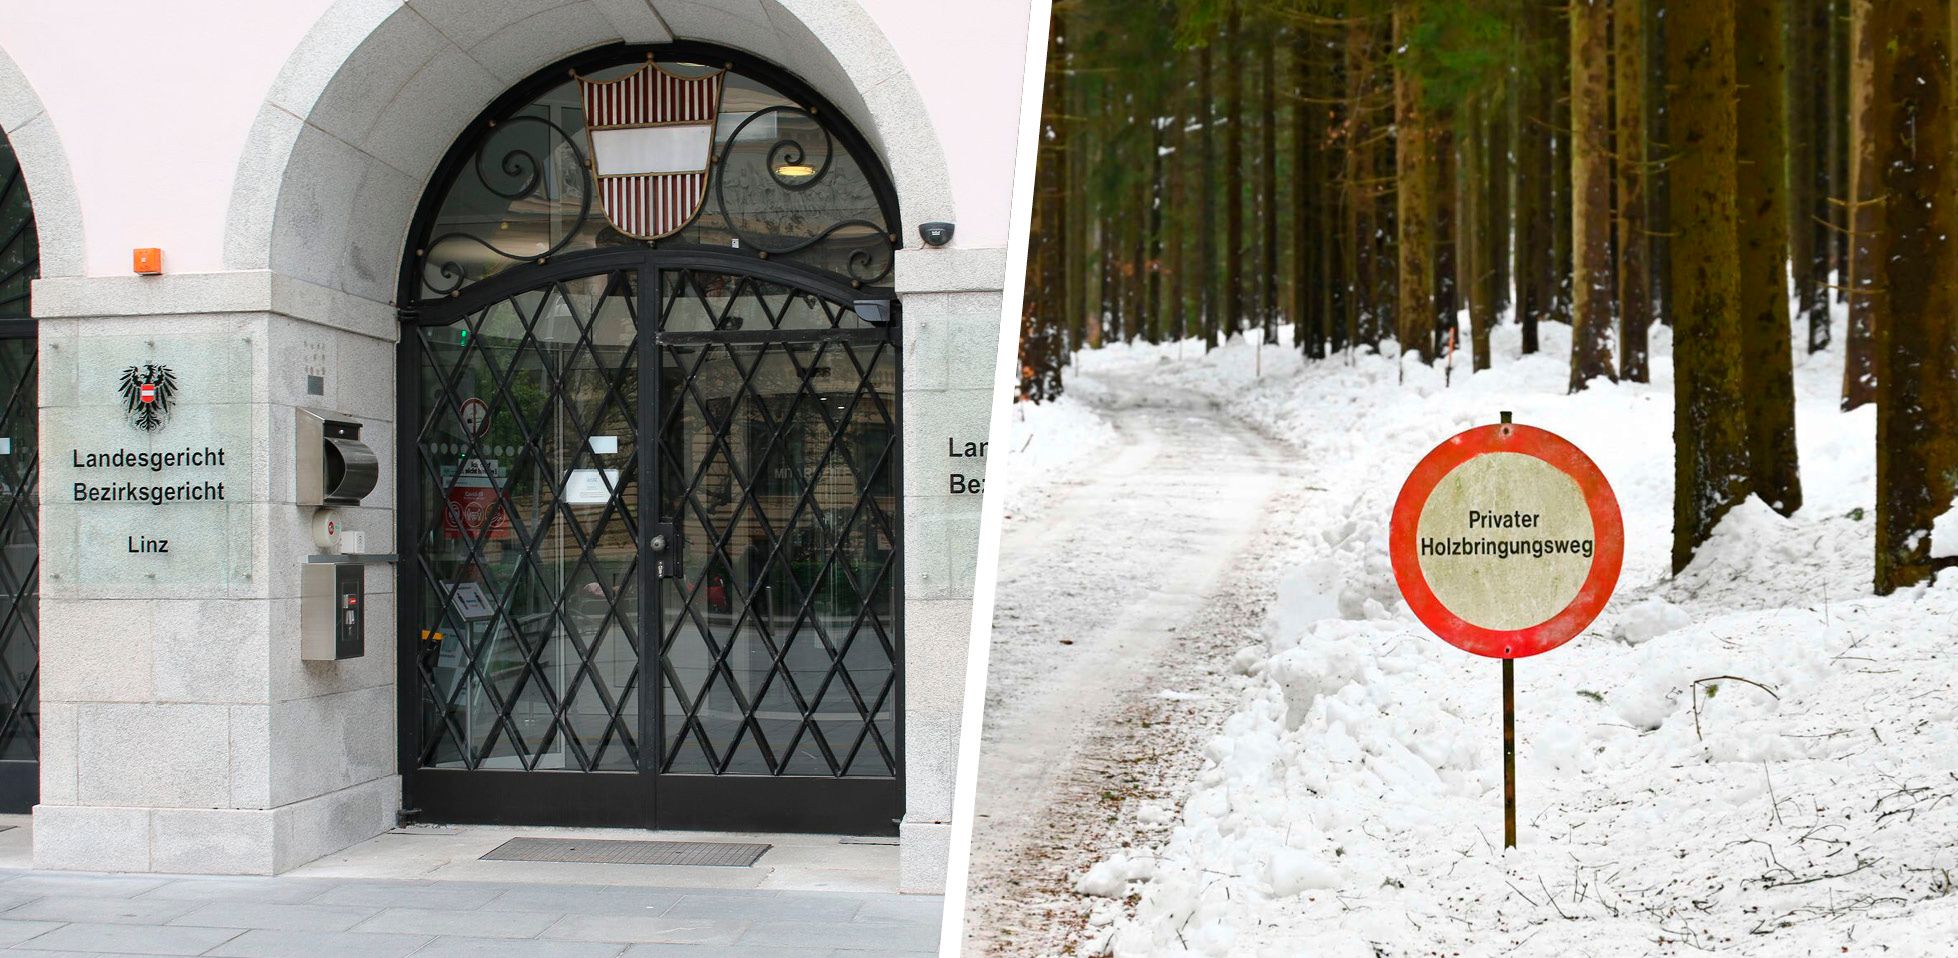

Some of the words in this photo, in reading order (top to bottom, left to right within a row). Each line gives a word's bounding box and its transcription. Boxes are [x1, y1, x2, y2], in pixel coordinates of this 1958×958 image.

[73, 447, 225, 472] Landesgericht
[73, 481, 225, 506] Bezirksgericht
[1469, 510, 1540, 528] Privater
[128, 535, 169, 553] Linz
[1421, 537, 1593, 559] Holzbringungsweg
